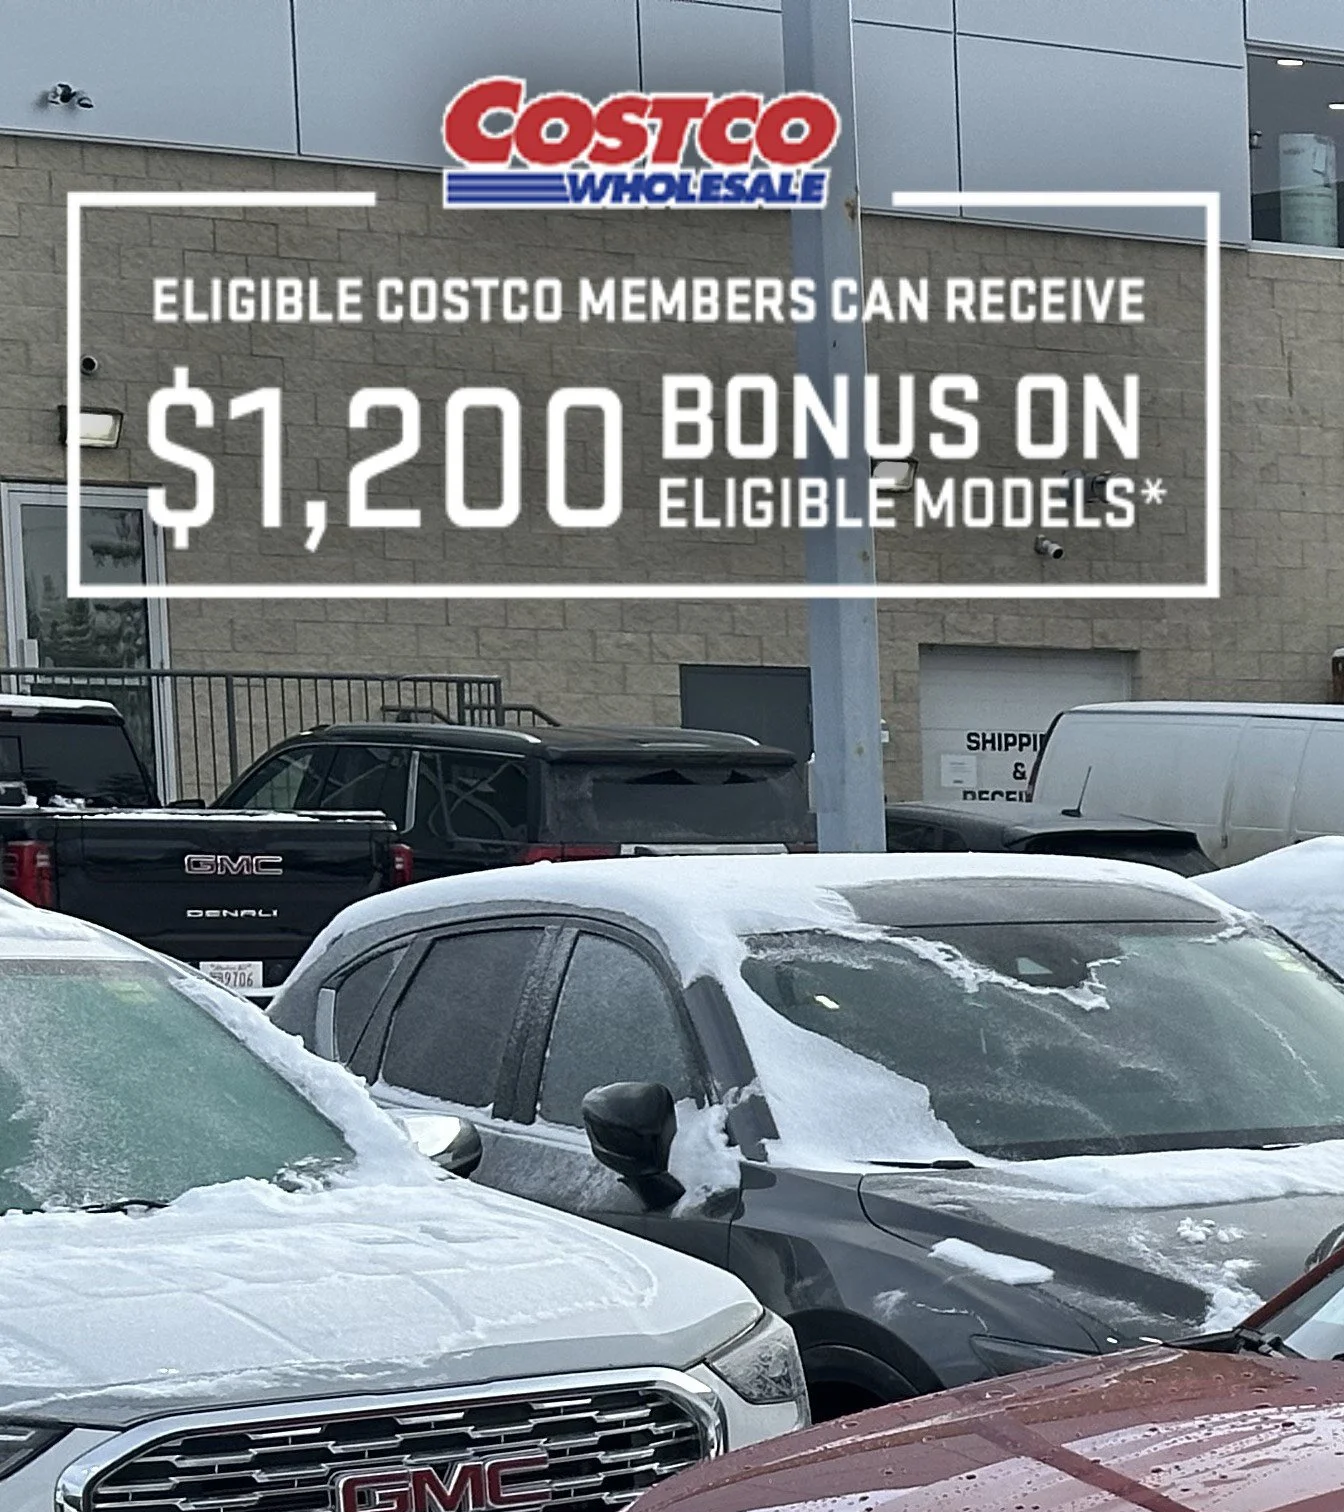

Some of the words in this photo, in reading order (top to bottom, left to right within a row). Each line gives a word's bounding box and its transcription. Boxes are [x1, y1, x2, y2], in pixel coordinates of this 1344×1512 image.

[966, 732, 1047, 752] SHIPPI
[1013, 762, 1027, 780] &
[962, 789, 1032, 802] RECEI
[184, 854, 283, 875] GMC
[187, 909, 278, 917] DENALI
